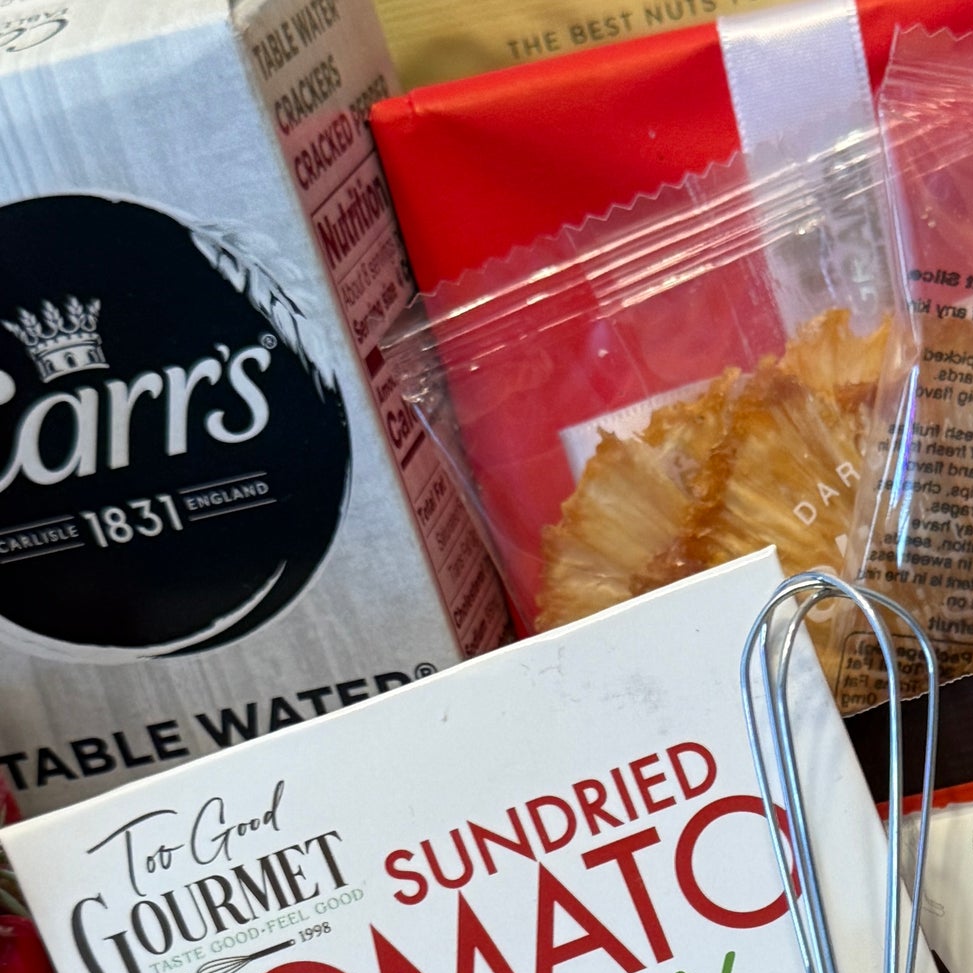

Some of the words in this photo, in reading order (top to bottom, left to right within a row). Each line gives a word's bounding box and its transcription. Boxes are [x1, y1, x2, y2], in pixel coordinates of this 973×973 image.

[252, 21, 300, 80] TABLE
[293, 0, 341, 48] WATER
[507, 31, 560, 59] THE
[570, 12, 633, 45] BEST
[645, 0, 717, 27] NUTS
[274, 54, 342, 136] CRACKERS
[293, 112, 354, 191] CRACKED
[317, 175, 390, 270] Nutrition
[79, 494, 184, 547] 1831
[186, 480, 270, 511] ENGLAND
[0, 720, 191, 791] TABLE
[87, 809, 184, 897] Too
[190, 780, 285, 865] Good
[384, 741, 718, 905] SUNDRIED
[297, 921, 332, 943] 1998
